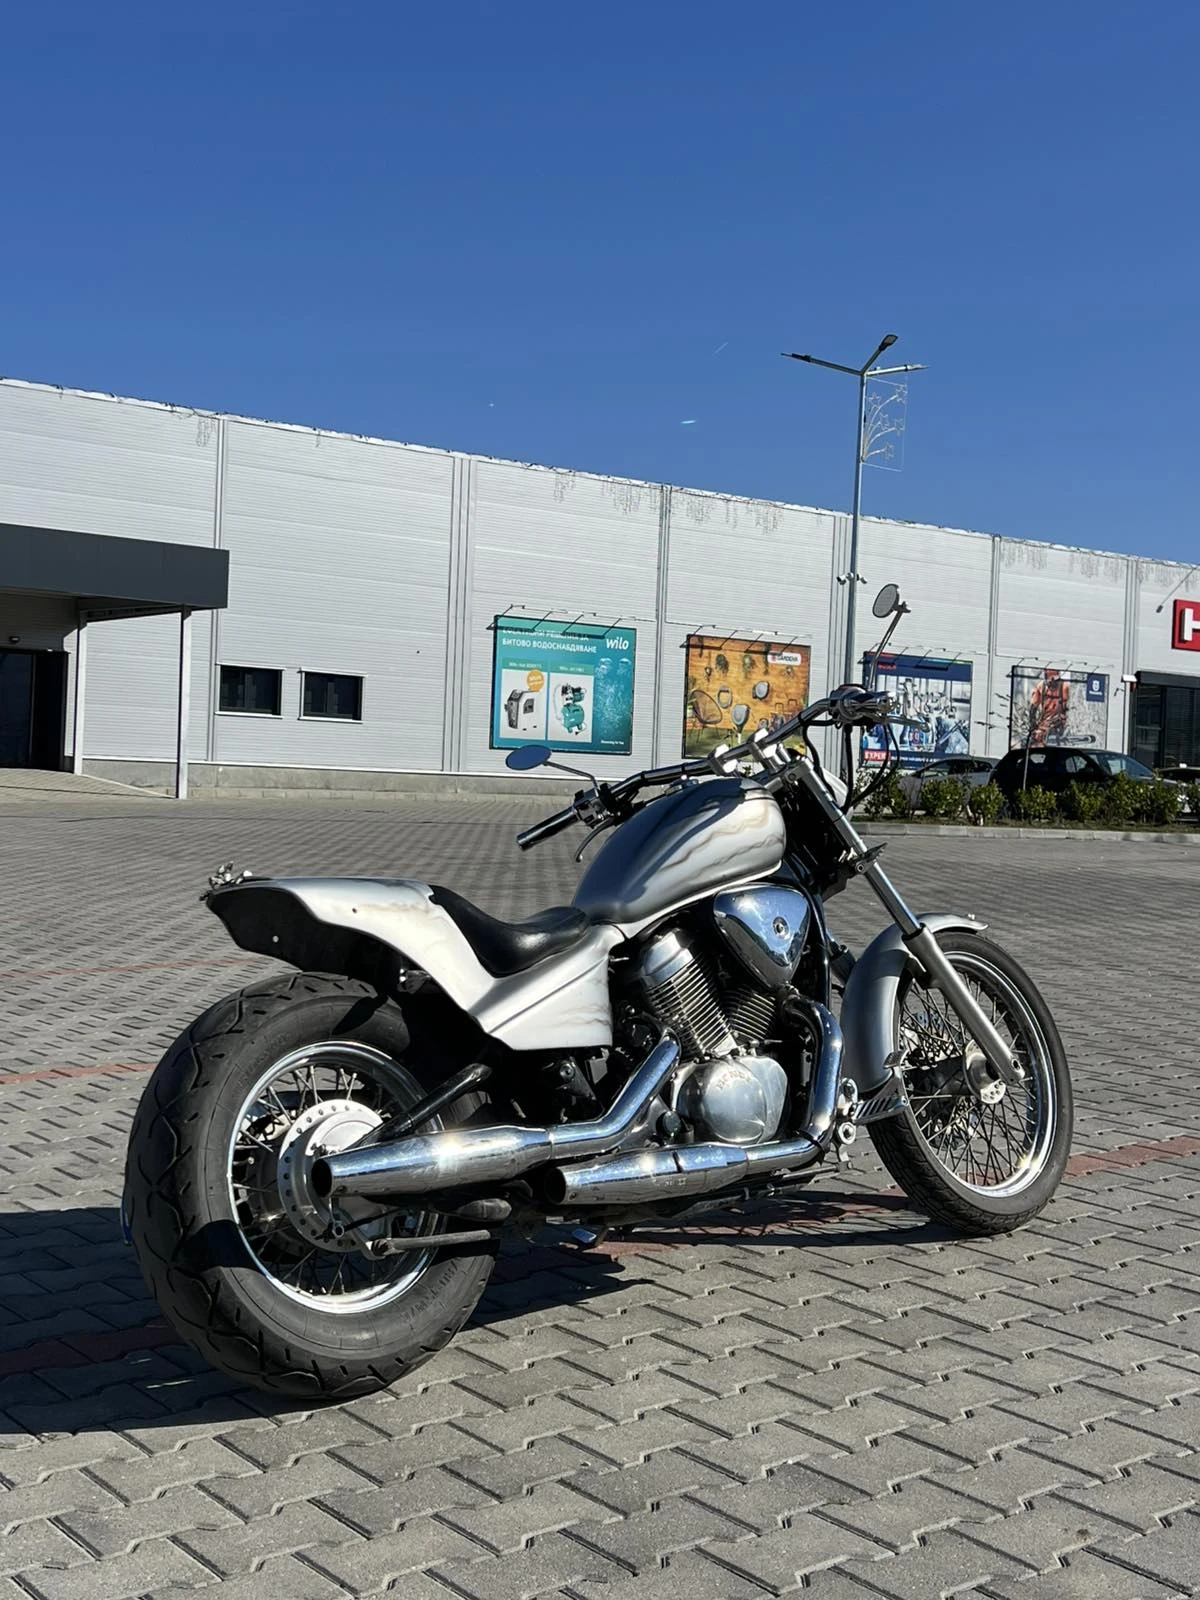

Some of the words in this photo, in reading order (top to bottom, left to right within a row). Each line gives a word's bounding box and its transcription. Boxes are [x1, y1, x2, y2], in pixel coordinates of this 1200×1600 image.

[502, 637, 531, 648] БИТОВО
[532, 641, 597, 653] ВОДОСНАБДЯВАНЕ
[606, 636, 629, 650] wilo
[864, 750, 891, 760] EXPER
